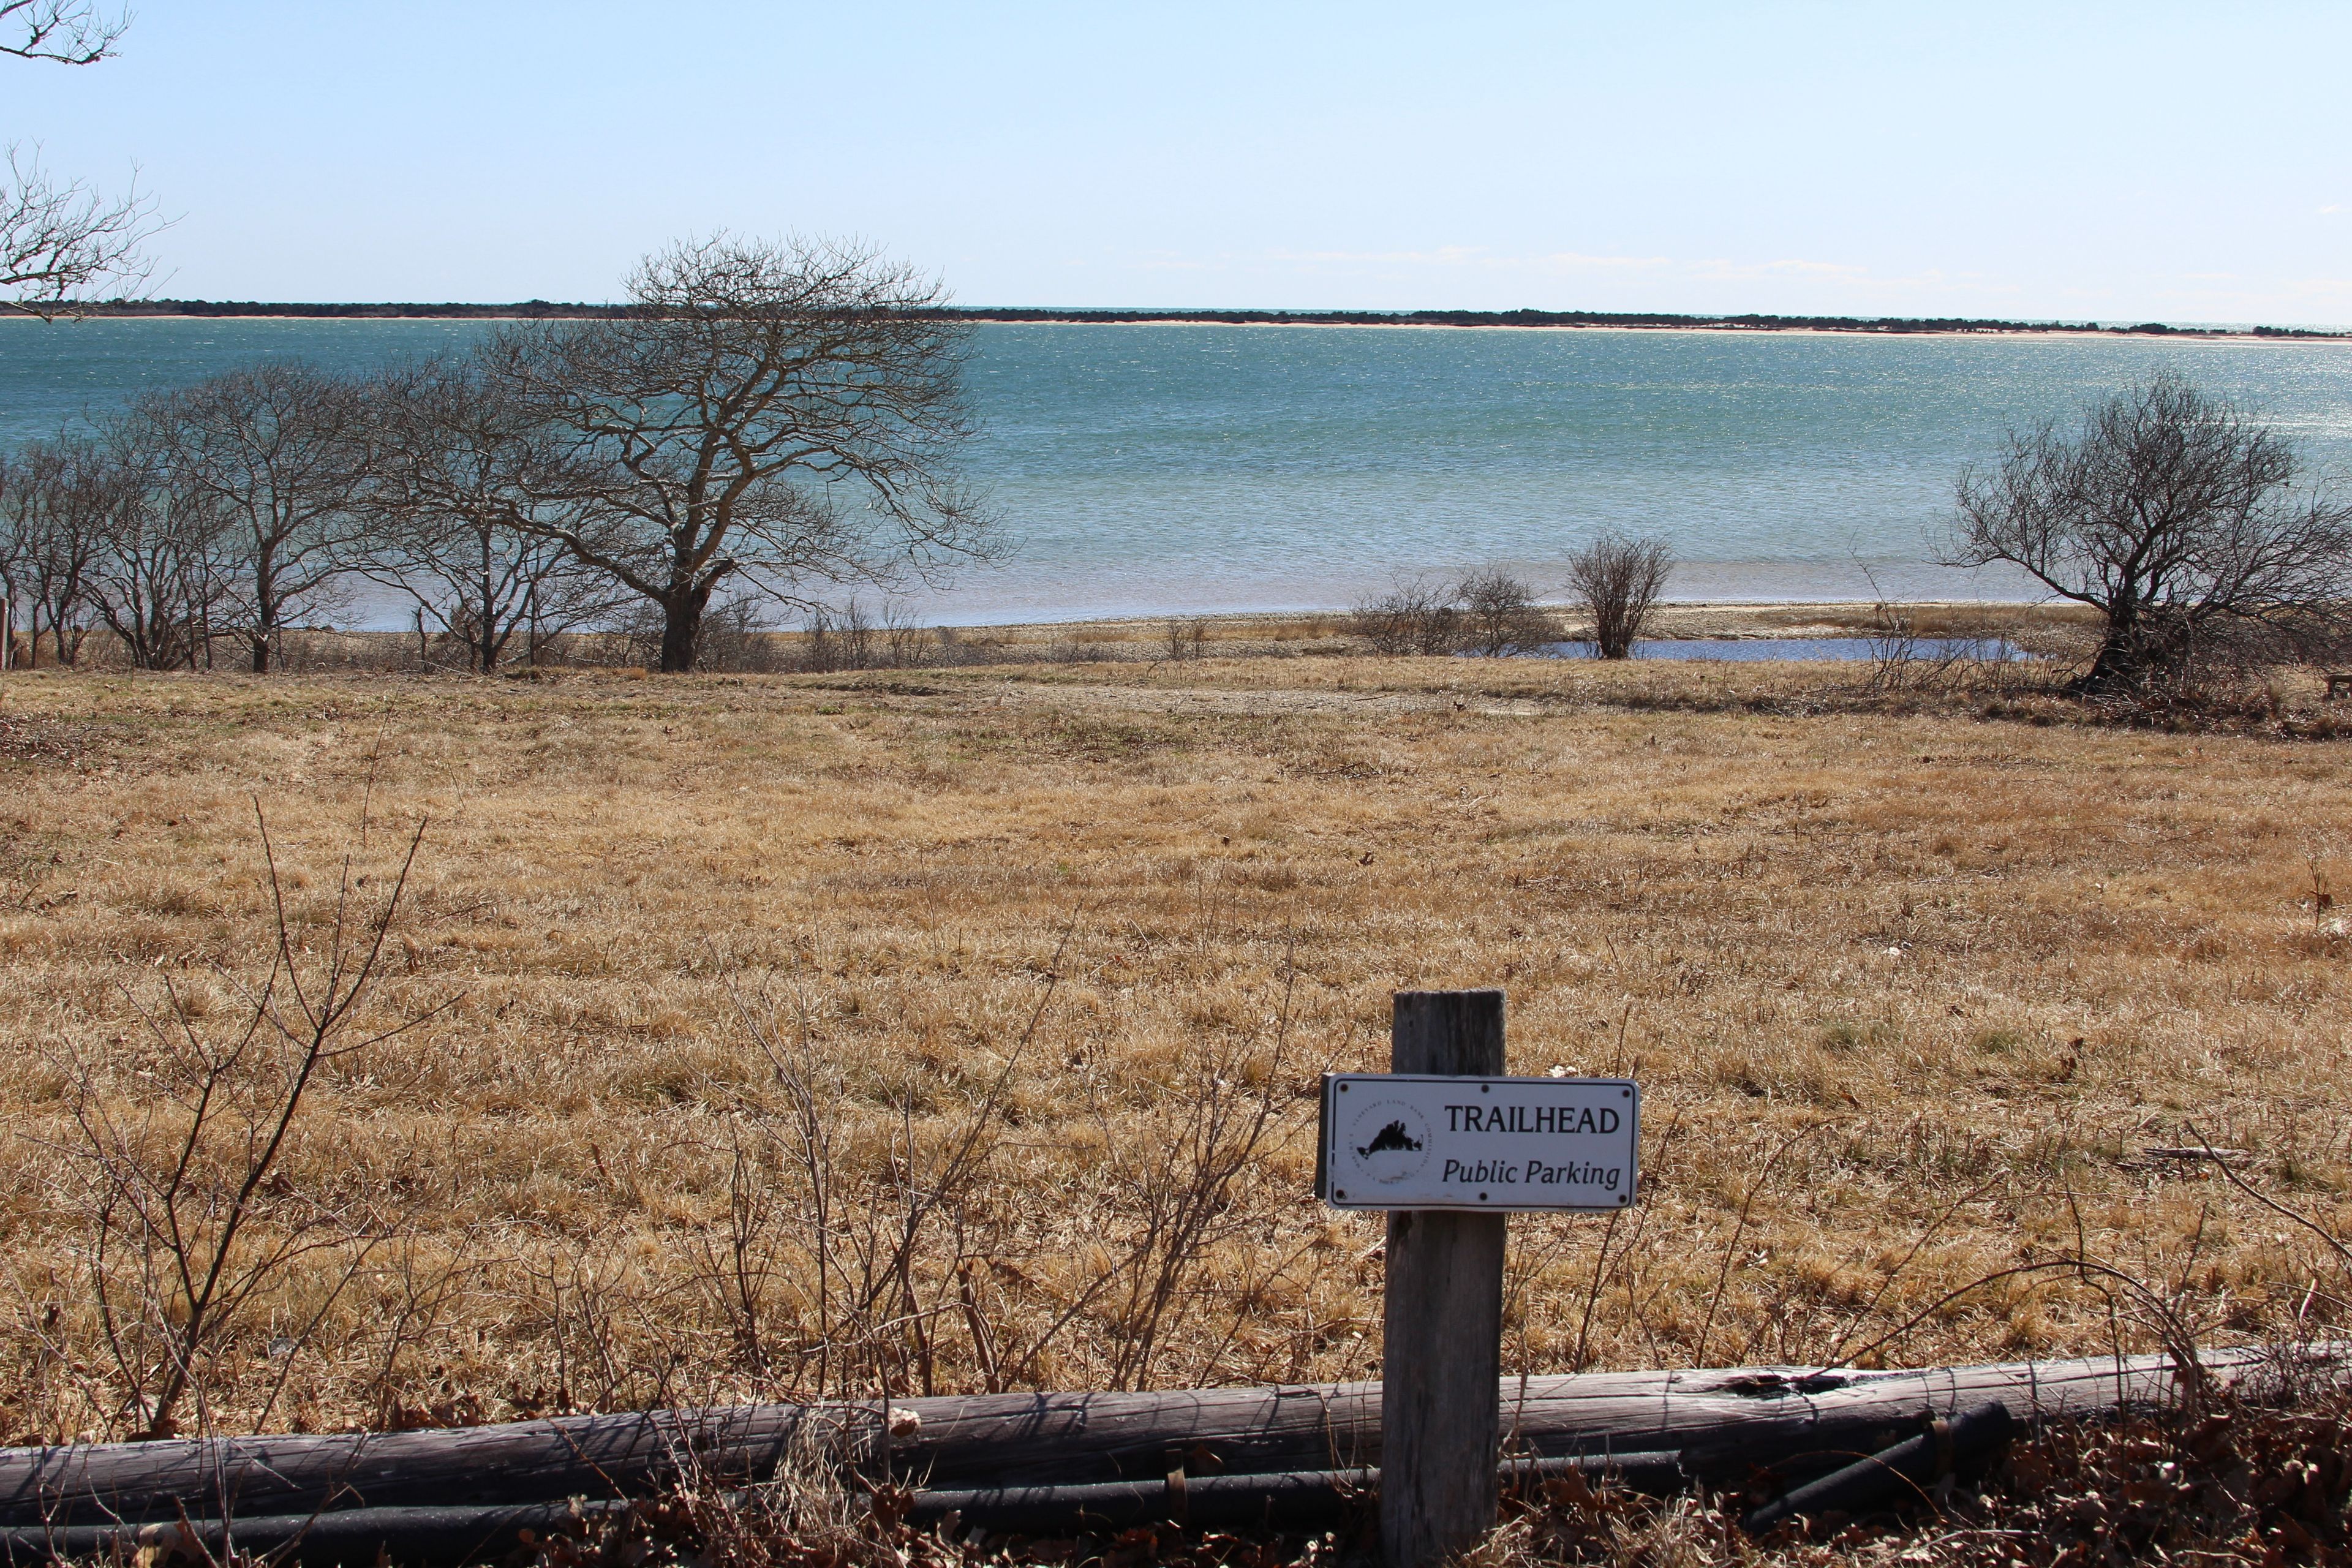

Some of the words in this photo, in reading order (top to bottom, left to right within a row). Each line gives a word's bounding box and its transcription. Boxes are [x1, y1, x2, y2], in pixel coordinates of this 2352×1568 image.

[1409, 1104, 1425, 1120] BANK
[1419, 1123, 1433, 1167] COMMISSION
[1444, 1106, 1619, 1134] TRAILHEAD
[1442, 1159, 1518, 1183] Public
[1525, 1160, 1621, 1191] Parking
